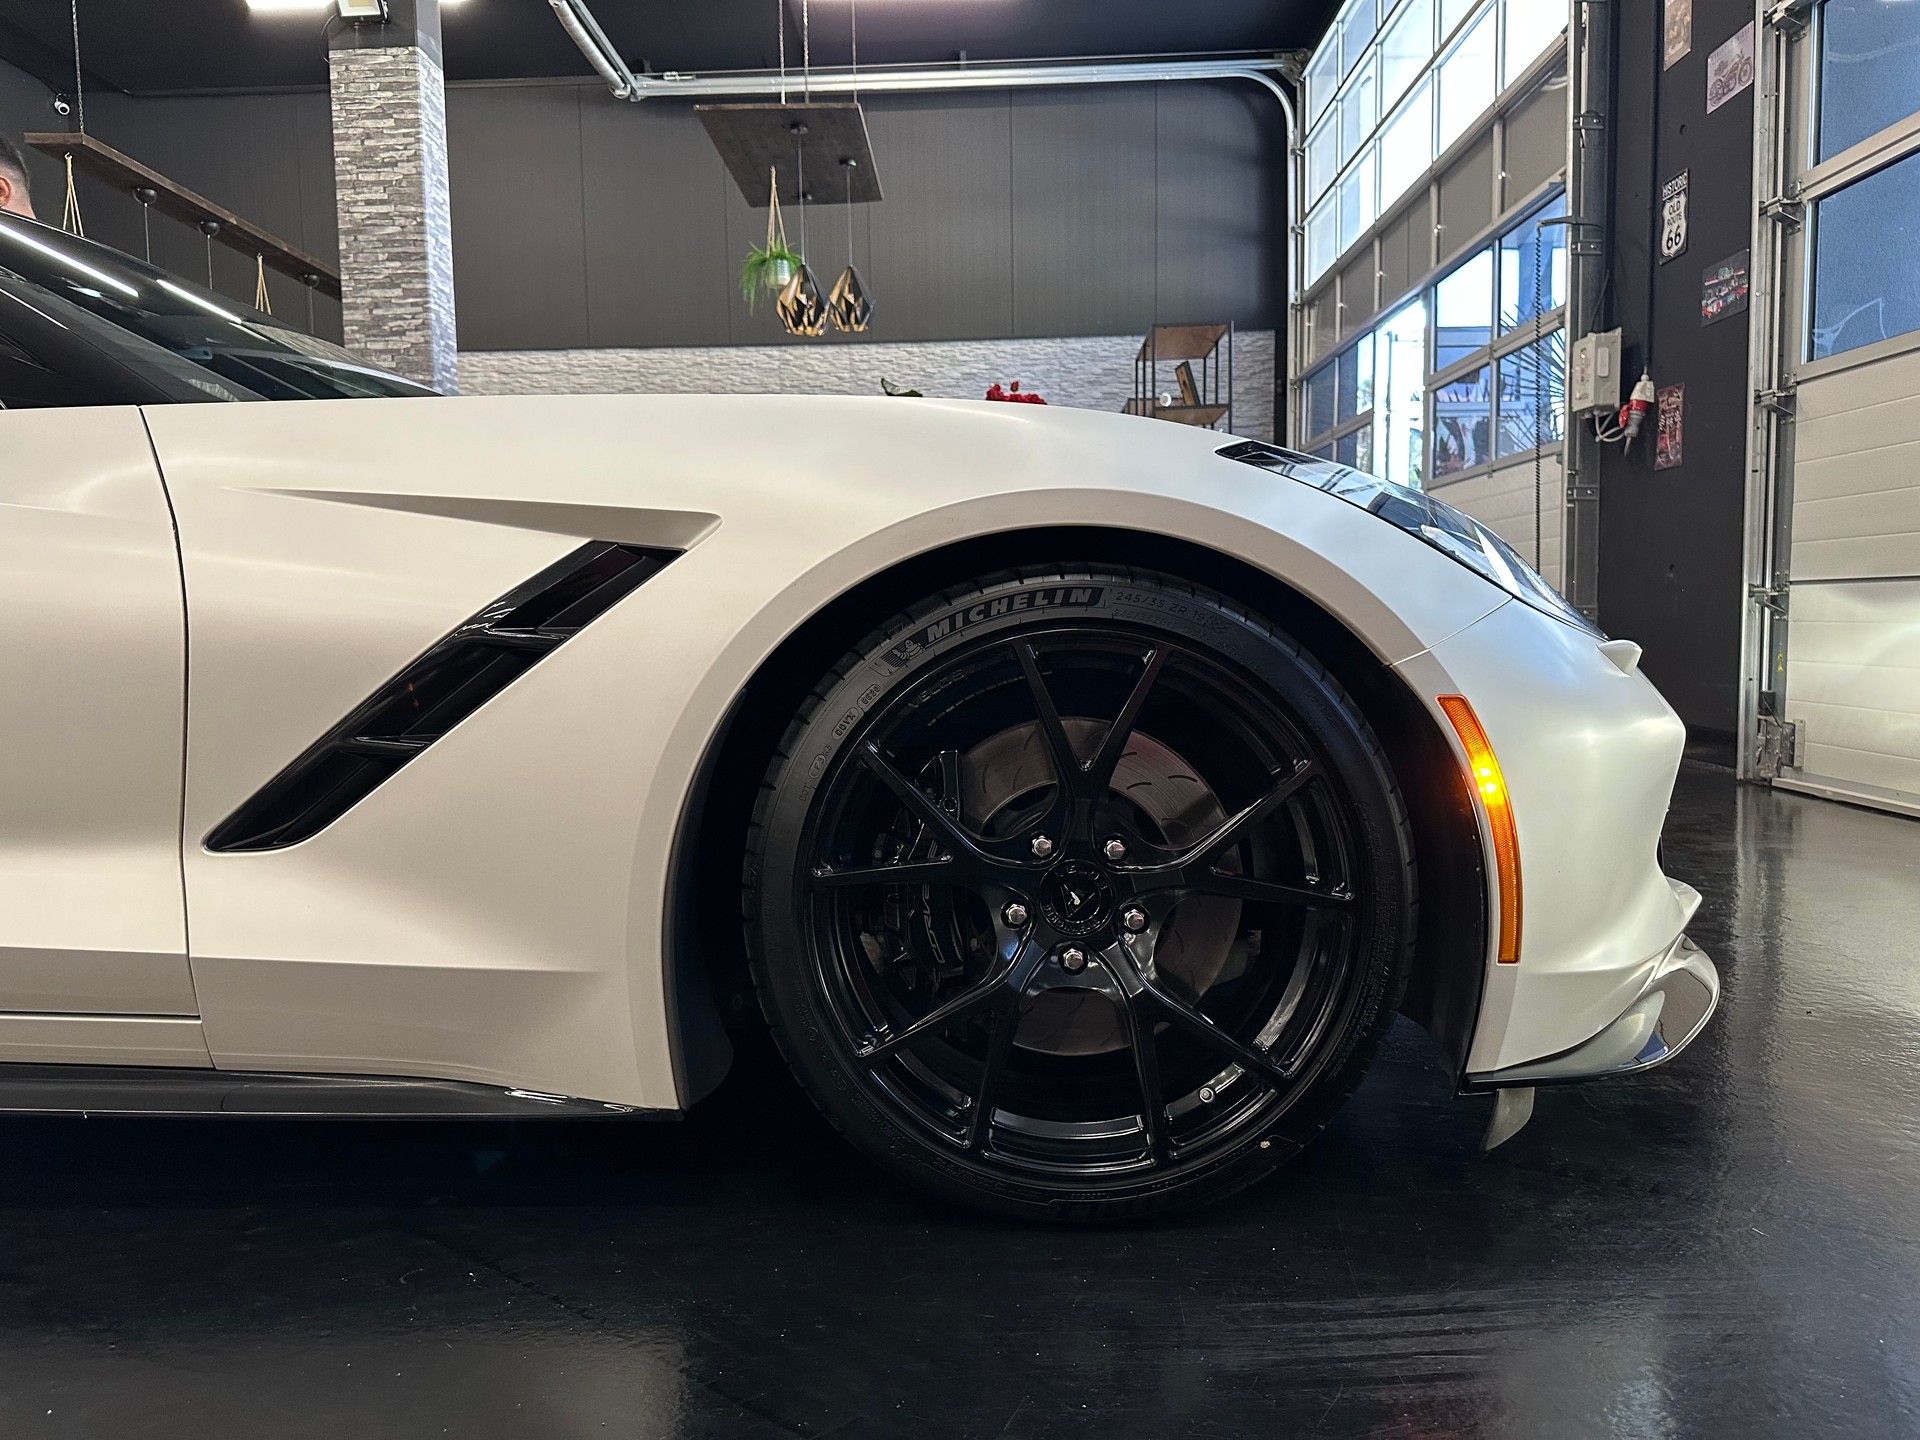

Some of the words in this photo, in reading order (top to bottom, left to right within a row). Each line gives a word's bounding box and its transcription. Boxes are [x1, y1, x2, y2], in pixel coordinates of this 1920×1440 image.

[1667, 200, 1682, 216] OLD
[1666, 211, 1683, 228] ROUTE
[1666, 224, 1682, 251] 66
[1115, 592, 1166, 609] 245/35
[1168, 602, 1188, 614] ZR
[927, 588, 1092, 643] MICHELIN
